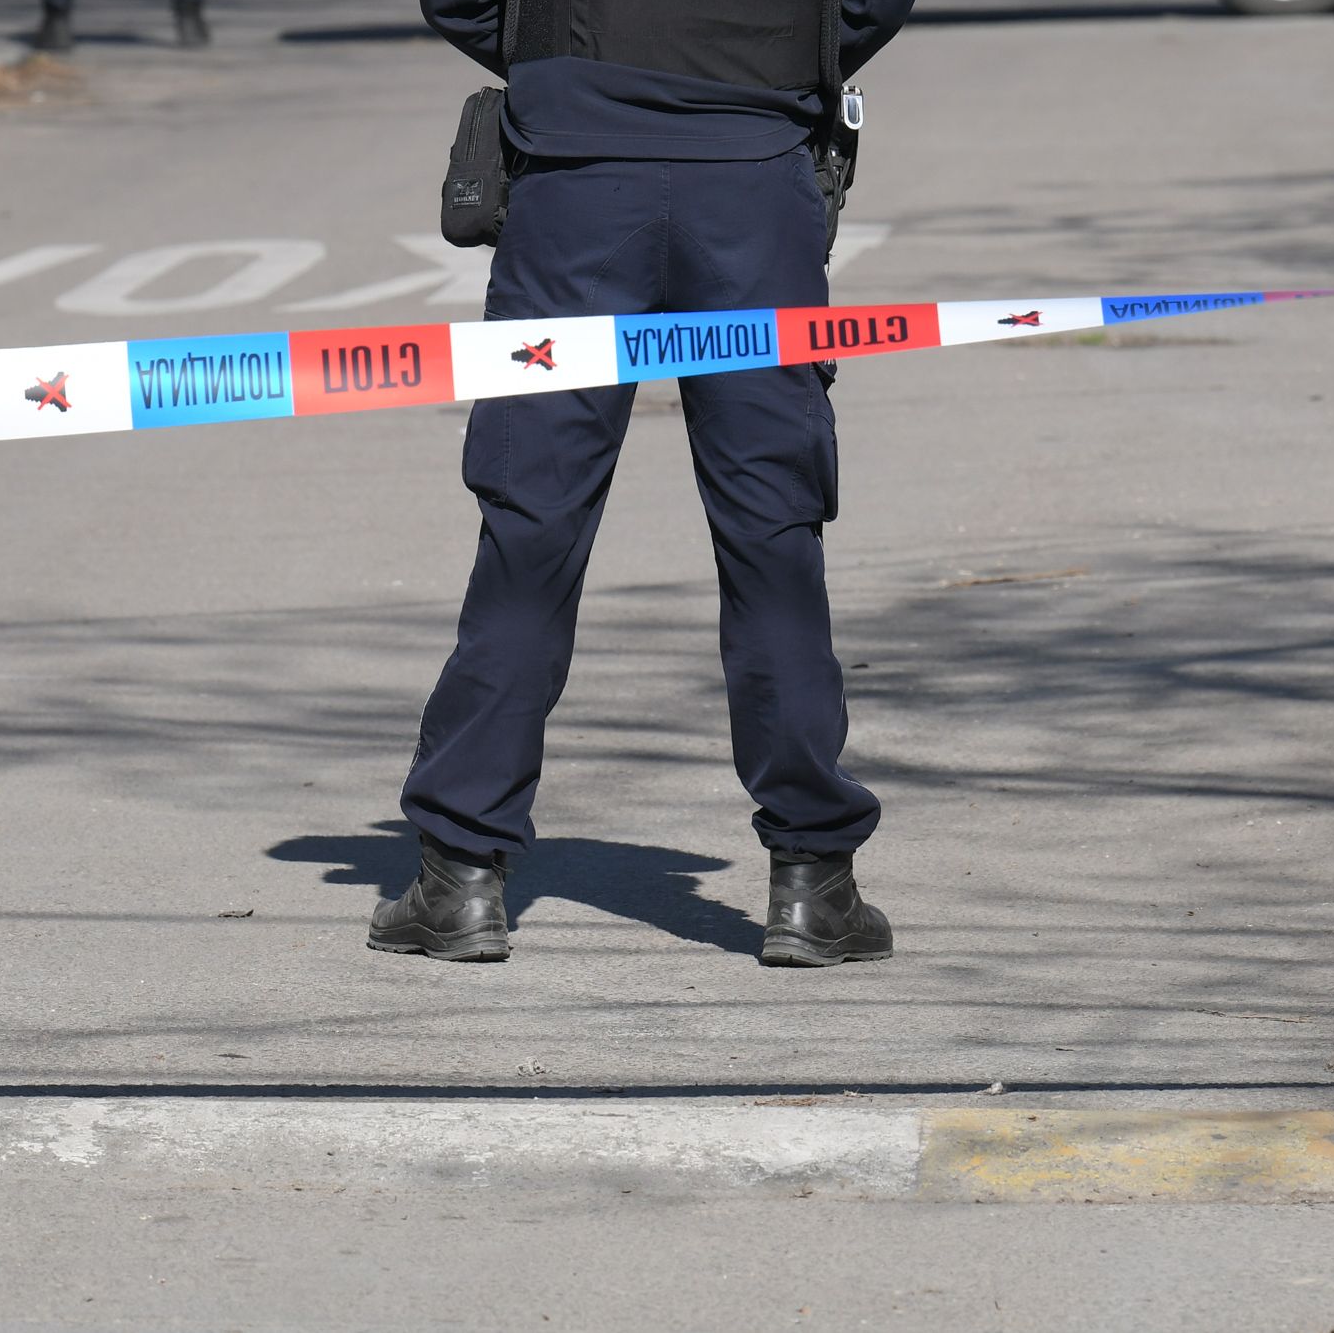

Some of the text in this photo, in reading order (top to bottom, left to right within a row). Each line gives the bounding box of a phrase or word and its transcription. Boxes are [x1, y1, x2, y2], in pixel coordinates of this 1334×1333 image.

[623, 322, 772, 367] ПОЛИЦИЈА
[808, 315, 908, 351] СТОП
[135, 351, 285, 410] ПОЛИЦИЈА
[321, 342, 422, 395] СТОП
